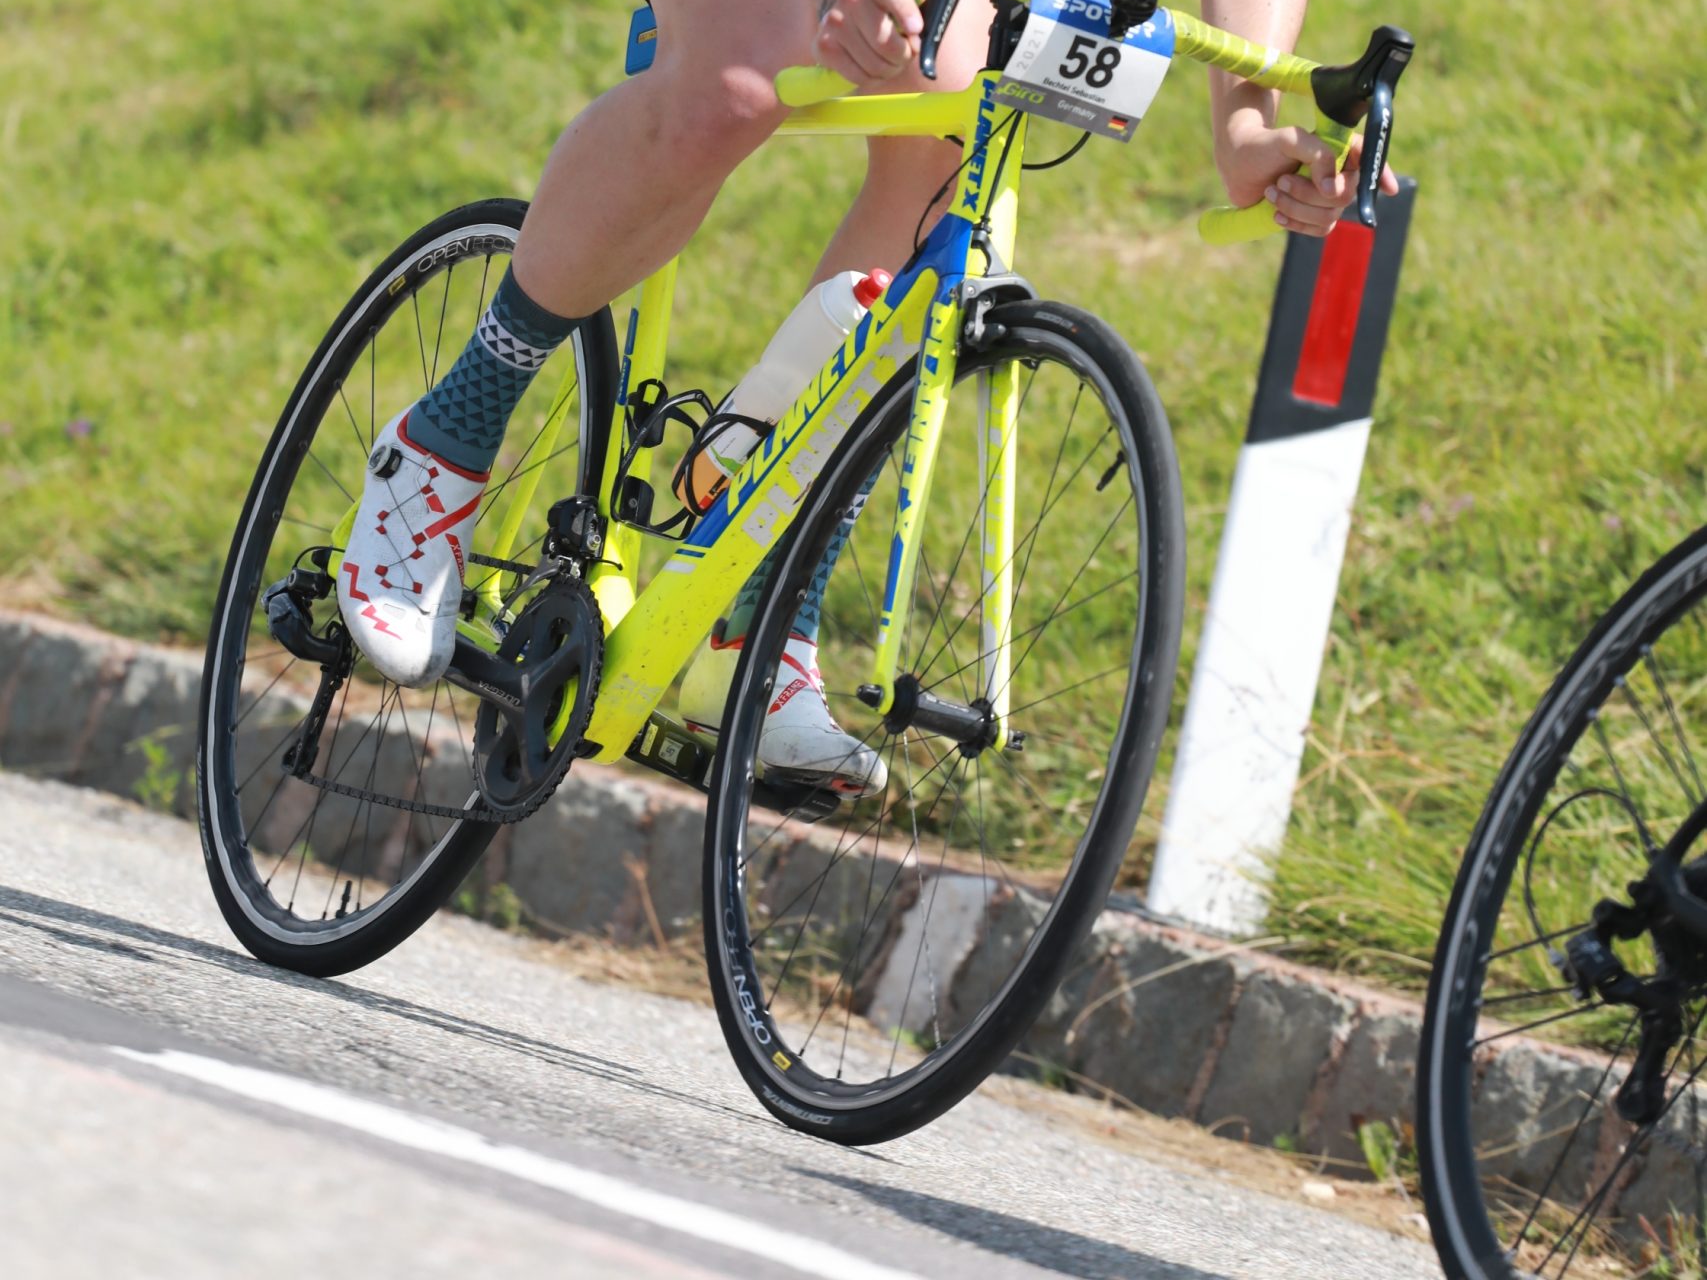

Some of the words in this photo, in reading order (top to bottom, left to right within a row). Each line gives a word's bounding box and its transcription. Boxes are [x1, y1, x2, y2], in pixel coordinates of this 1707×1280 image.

[1016, 29, 1045, 70] 2021
[1059, 34, 1121, 88] 58
[1057, 99, 1097, 120] Germany
[968, 78, 997, 190] PLANET
[1369, 107, 1390, 190] ULTEGRA
[962, 187, 980, 213] X
[418, 238, 470, 272] OPEN
[472, 237, 506, 250] PRO
[478, 680, 520, 706] ULTEGRA
[734, 975, 771, 1045] OPEN
